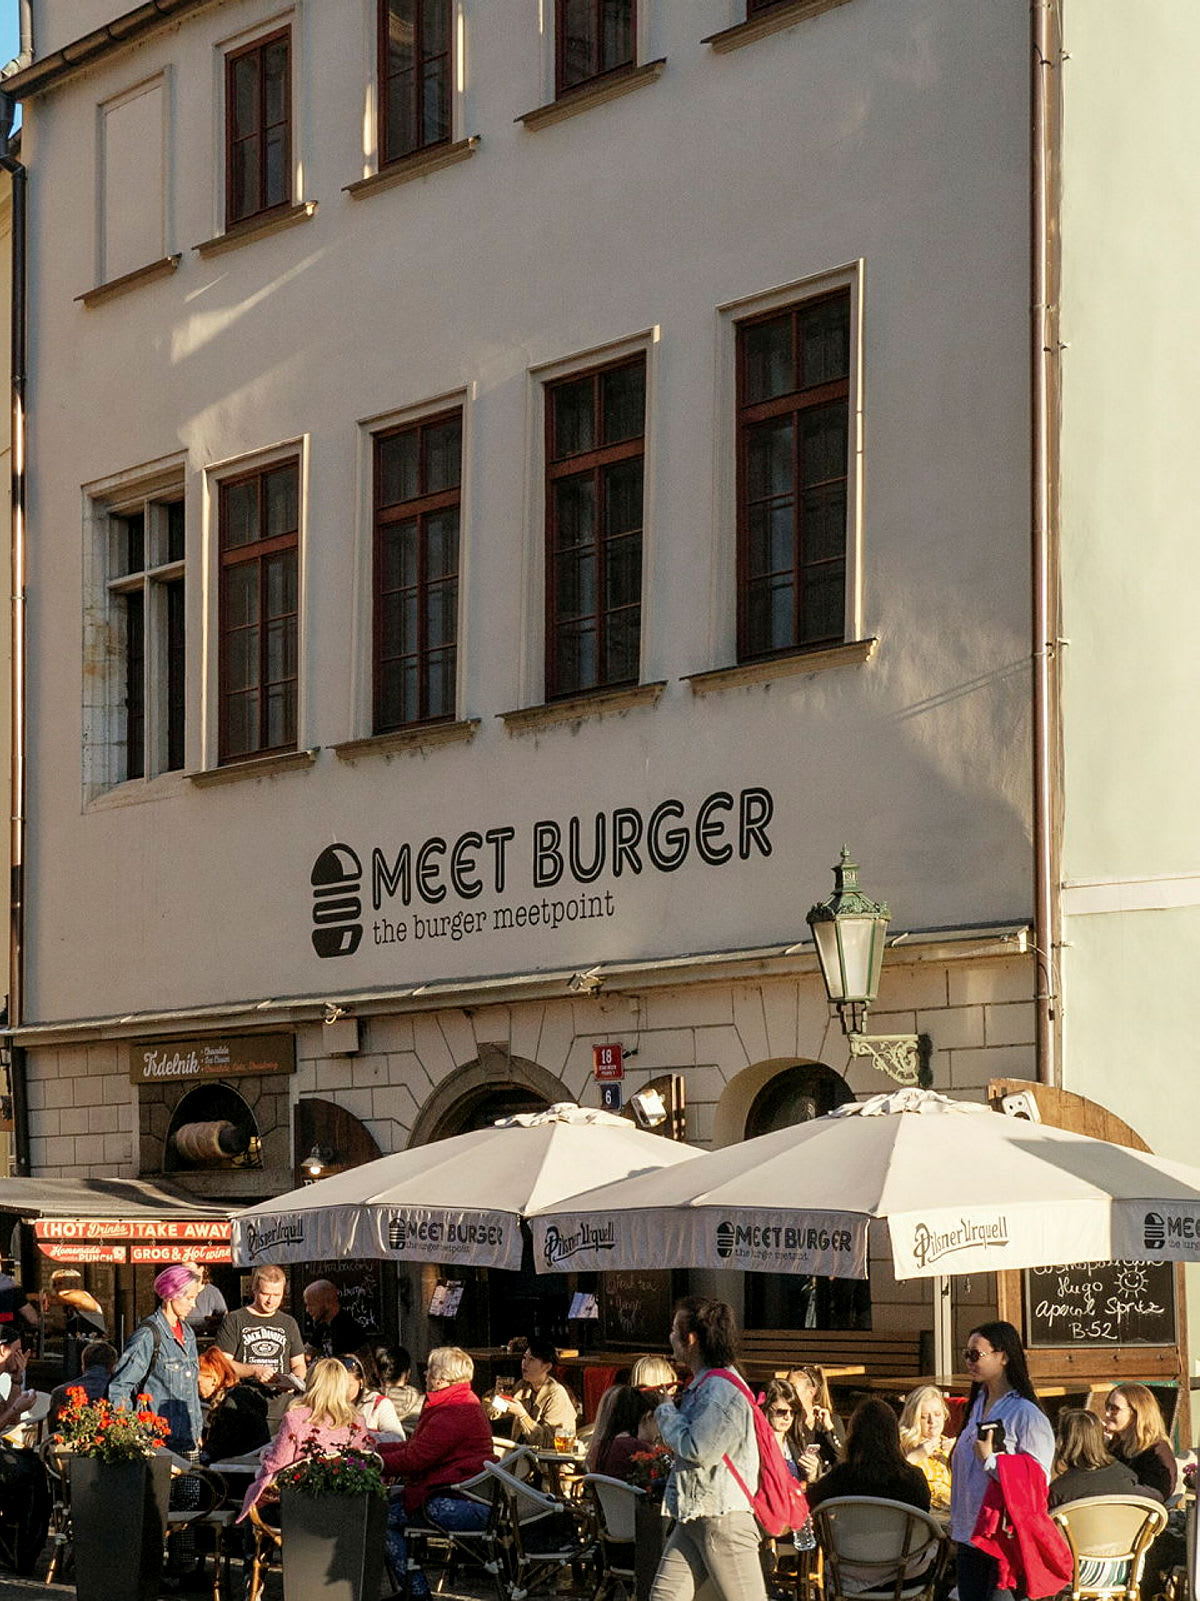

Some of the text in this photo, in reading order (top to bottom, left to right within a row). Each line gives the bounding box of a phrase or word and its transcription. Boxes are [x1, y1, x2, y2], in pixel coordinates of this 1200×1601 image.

[372, 786, 774, 910] MEET BURGER
[372, 888, 615, 945] the burger meetpoint
[601, 1048, 612, 1065] 18
[605, 1089, 612, 1105] 6
[134, 1223, 178, 1237] TAKE
[184, 1223, 229, 1237] AWAY
[406, 1220, 503, 1246] MEET BURGER
[735, 1225, 852, 1252] MEET BURGER
[913, 1216, 1009, 1268] Pilsner Urquell
[50, 1245, 101, 1257] Homemade
[133, 1246, 231, 1262] GROG & Hot wine
[544, 1221, 615, 1267] Pilsner Urquell
[78, 1253, 113, 1262] PUNCH
[1057, 1276, 1104, 1303] Hugo
[1104, 1296, 1165, 1324] Spritz
[242, 1331, 261, 1345] JACK
